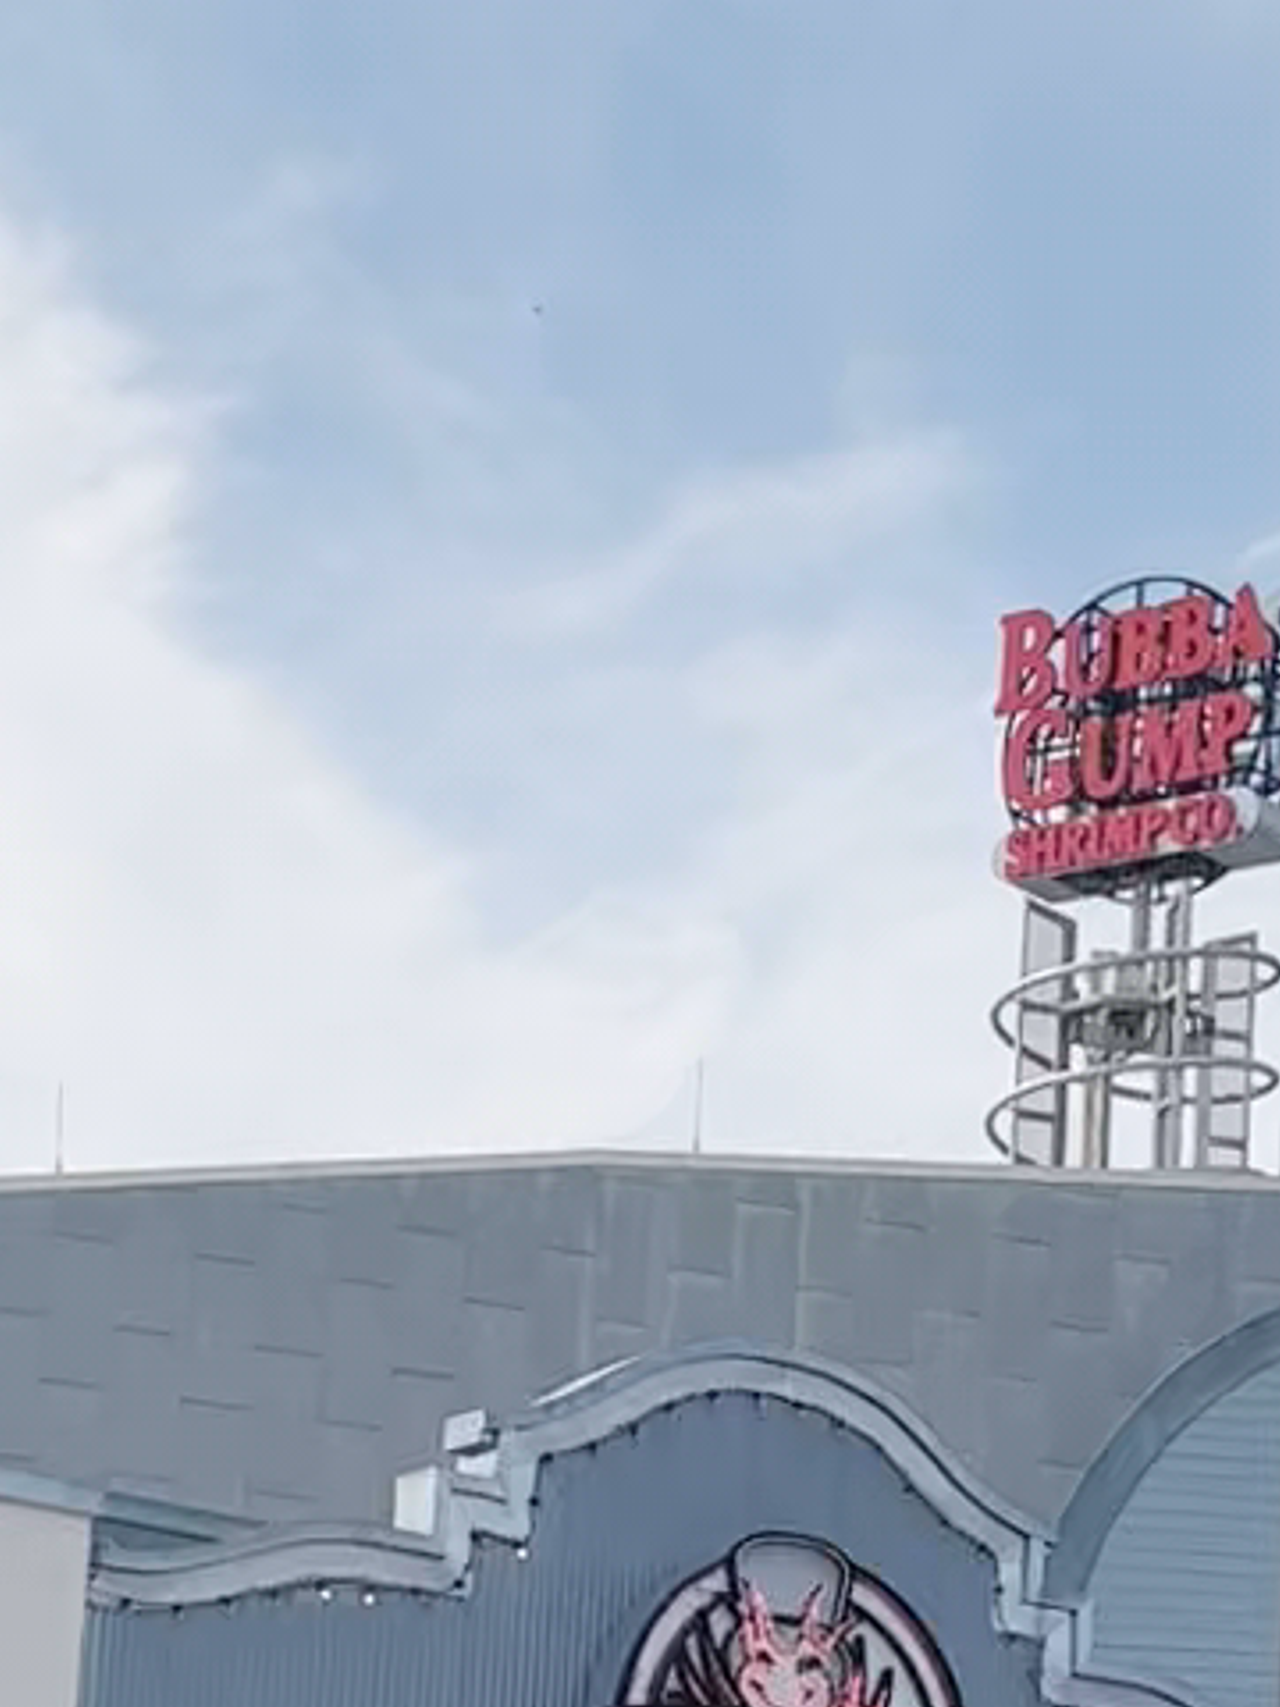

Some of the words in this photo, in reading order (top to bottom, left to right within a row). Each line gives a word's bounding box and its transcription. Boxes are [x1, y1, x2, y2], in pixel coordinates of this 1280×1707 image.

[994, 583, 1272, 716] BUBBA
[1003, 694, 1252, 809] GUMP
[1004, 809, 1169, 882] SHRIMP
